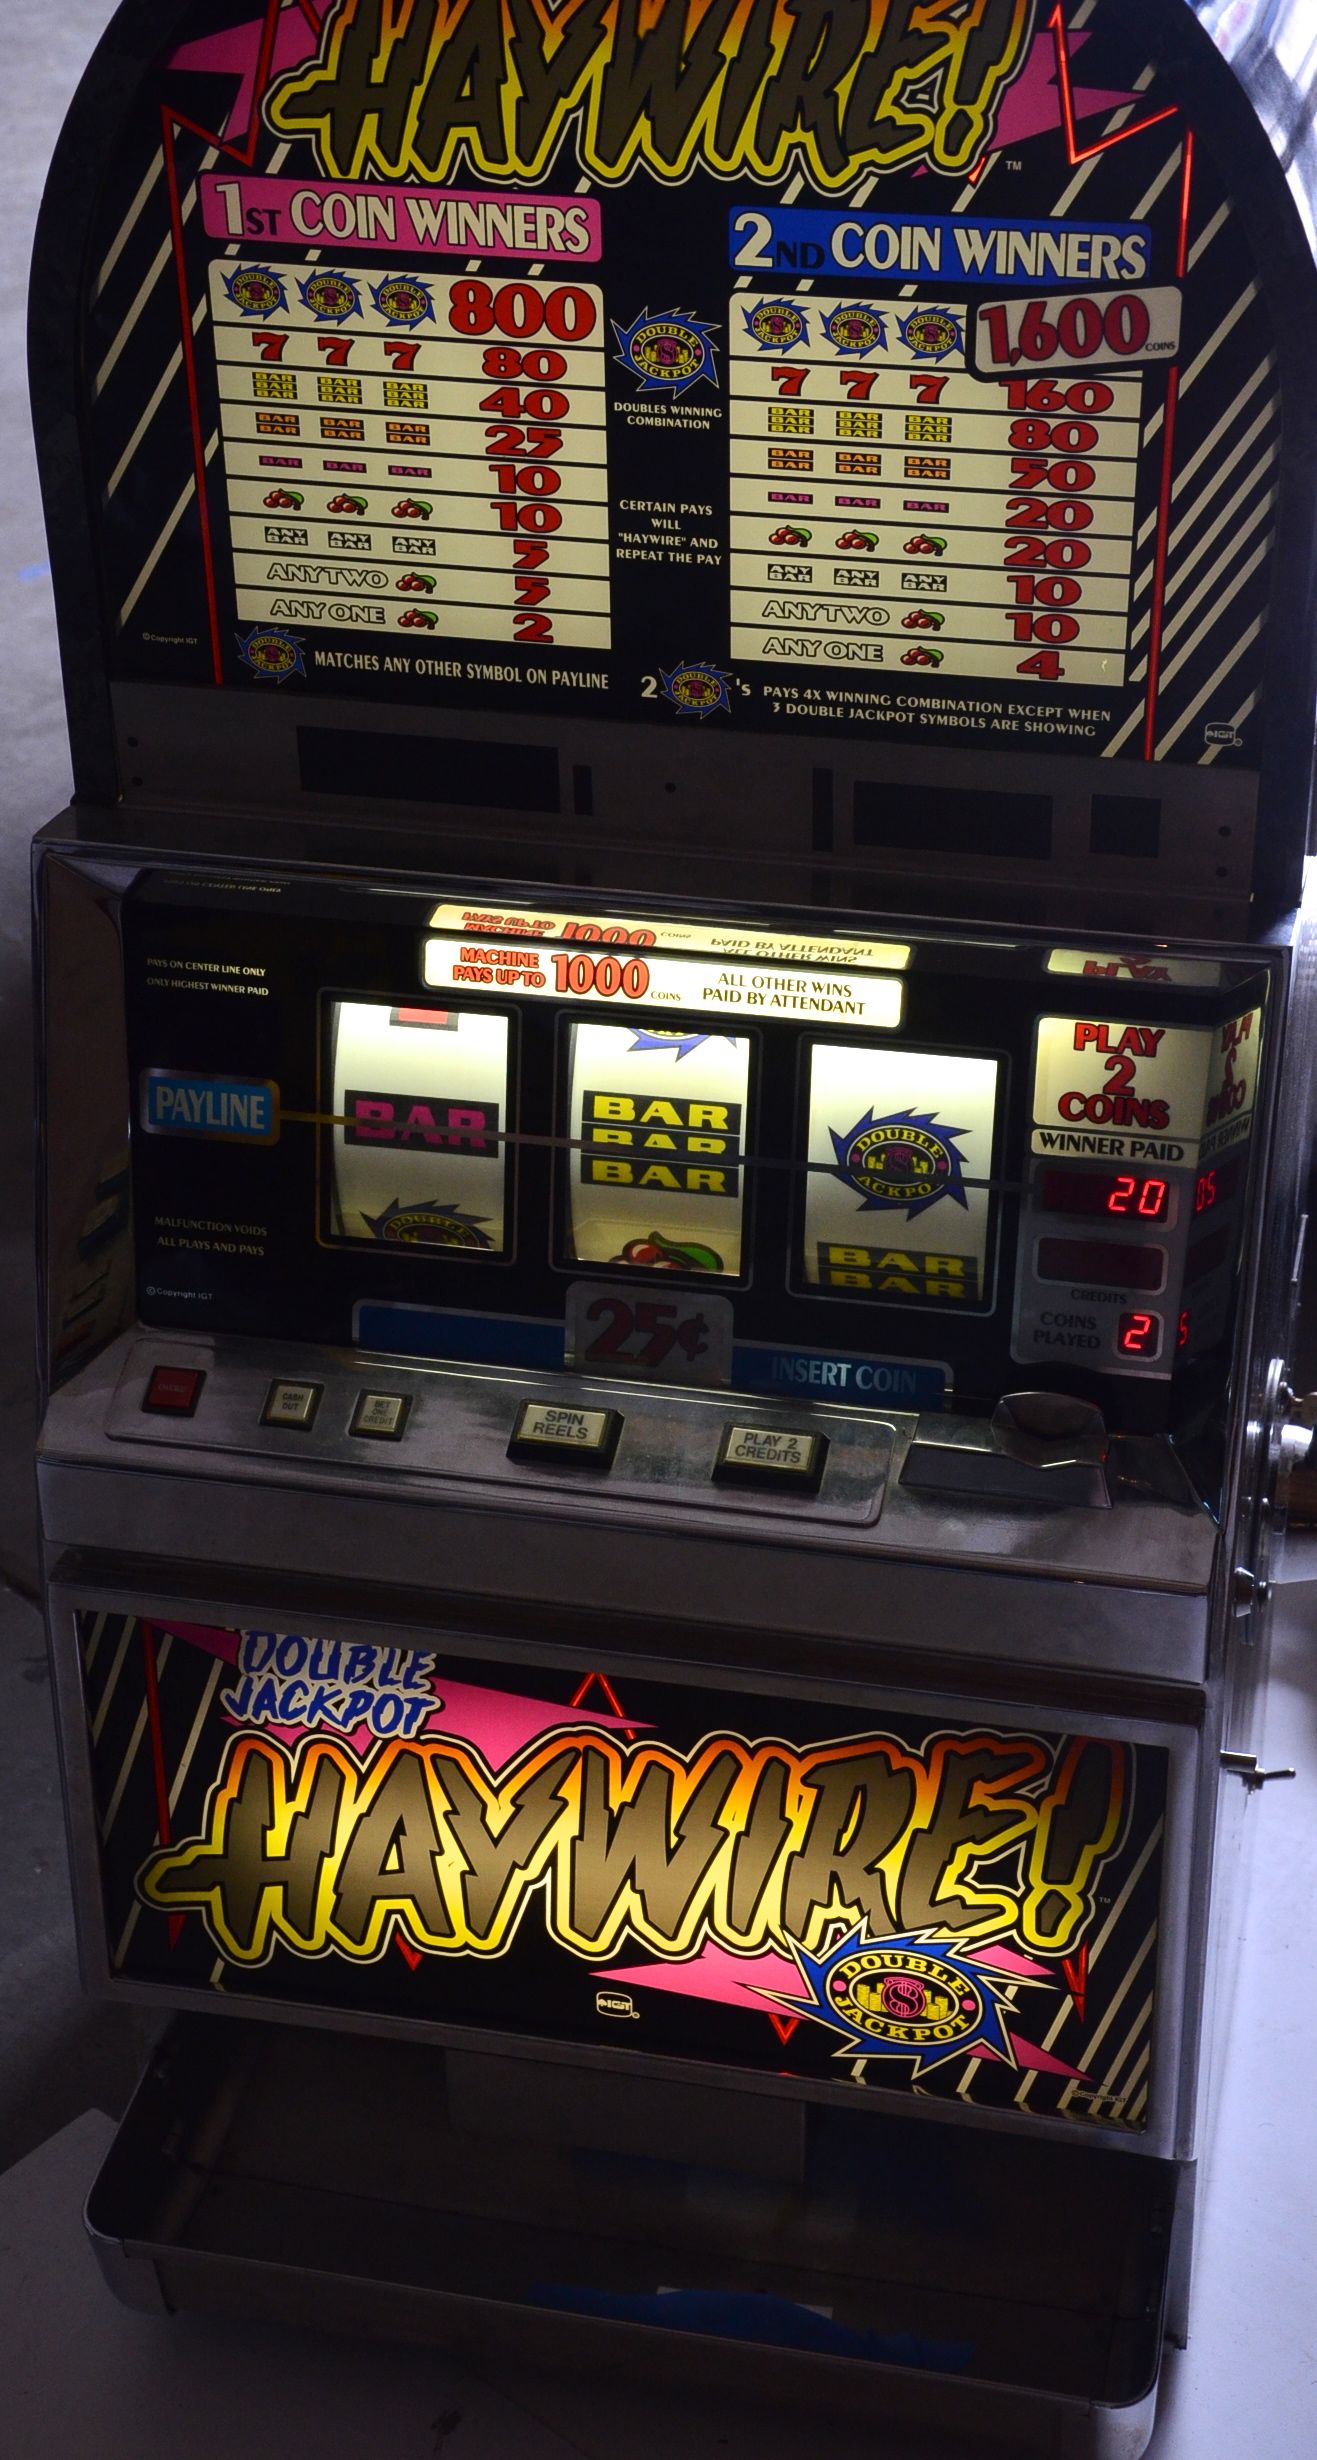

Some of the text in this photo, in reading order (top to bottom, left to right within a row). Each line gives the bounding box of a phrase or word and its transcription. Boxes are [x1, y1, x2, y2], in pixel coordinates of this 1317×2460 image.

[268, 0, 1030, 192] HAYWIRE!
[215, 183, 591, 254] 1ST COIN WINNERS
[733, 212, 1147, 280] 2ND COIN WINNERS
[448, 279, 597, 342] 800
[636, 324, 698, 347] DOUBLE
[979, 294, 1151, 368] 1,600
[1144, 341, 1176, 352] COINS
[252, 332, 421, 371] 7 7 7
[482, 346, 567, 381] 80
[634, 354, 699, 378] JACKPOT
[255, 373, 295, 381] BAR
[771, 366, 950, 404] 7 7 7
[479, 387, 570, 421] 40
[614, 402, 722, 418] DOUBLES WINNING
[770, 407, 812, 417] BAR
[999, 379, 1114, 414] 160
[257, 414, 297, 422] BAR
[627, 415, 710, 430] COMBINATION
[484, 424, 564, 459] 25
[1008, 417, 1099, 453] 80
[489, 464, 561, 496] 10
[1009, 457, 1096, 492] 50
[490, 501, 562, 533] 10
[620, 500, 713, 516] CERTAIN PAYS
[1005, 497, 1093, 531] 20
[267, 527, 305, 536] ANY
[651, 518, 681, 530] WILL
[268, 536, 307, 545] BAR
[513, 540, 550, 569] 5
[618, 532, 718, 549] "HAYWIRE" AND
[1004, 535, 1091, 569] 20
[616, 548, 722, 566] REPEAT THE PAY
[514, 576, 551, 606] 5
[1007, 575, 1082, 606] 10
[513, 612, 554, 643] 2
[1005, 612, 1080, 643] 10
[314, 651, 609, 690] MATCHES ANY OTHER SYMBOL ON PAYLINE
[1016, 650, 1065, 680] 4
[640, 676, 658, 698] 2
[763, 686, 1111, 722] PAYS 4X WINNING COMBINATION EXCEPT WHEN
[772, 702, 1096, 737] 3 DOUBLE JACKPOT SYMBOLS ARE SHOWING
[147, 958, 266, 977] PAYS ON CENTER LINE ONLY
[460, 947, 539, 969] MACHINE
[147, 977, 269, 996] ONLY HIGHEST WINNER PAID
[453, 965, 546, 989] PAYS UP TO
[551, 953, 650, 1000] 1000
[718, 972, 852, 998] ALL OTHER WINS
[651, 990, 681, 1002] COINS
[703, 987, 866, 1016] PAID BY ATTENDANT
[1074, 1022, 1165, 1057] PLAY
[1103, 1055, 1136, 1097] 2
[156, 1086, 265, 1130] PAYLINE
[355, 1098, 488, 1149] BAR
[593, 1094, 729, 1131] BAR
[1058, 1091, 1170, 1130] COINS
[856, 1128, 944, 1159] DOUBLE
[1039, 1132, 1184, 1162] WINNER PAID
[592, 1159, 727, 1193] BAR
[857, 1175, 934, 1199] ACKPO
[1107, 1176, 1168, 1215] 20
[154, 1216, 268, 1237] MALFUNCTION VOIDS
[158, 1236, 265, 1256] ALL PLAYS AND PAYS
[829, 1247, 965, 1278] BAR
[830, 1271, 966, 1299] BAR
[1071, 1289, 1127, 1304] CREDITS
[586, 1298, 709, 1367] 25¢
[1041, 1311, 1098, 1331] COINS
[1122, 1313, 1152, 1350] 2
[1033, 1329, 1101, 1349] PLAYED
[770, 1357, 917, 1394] INSERT COIN
[532, 1422, 588, 1440] REELS
[544, 1410, 584, 1426] SPIN
[734, 1445, 801, 1464] CREDITS
[744, 1432, 798, 1449] PLAY 2
[240, 1629, 438, 1692] DOUBLE
[220, 1675, 444, 1738] JACKPOT
[138, 1730, 1135, 1960] HAYWIRE!
[840, 1953, 970, 1996] DOUBLE
[834, 1996, 970, 2041] JACKPOT
